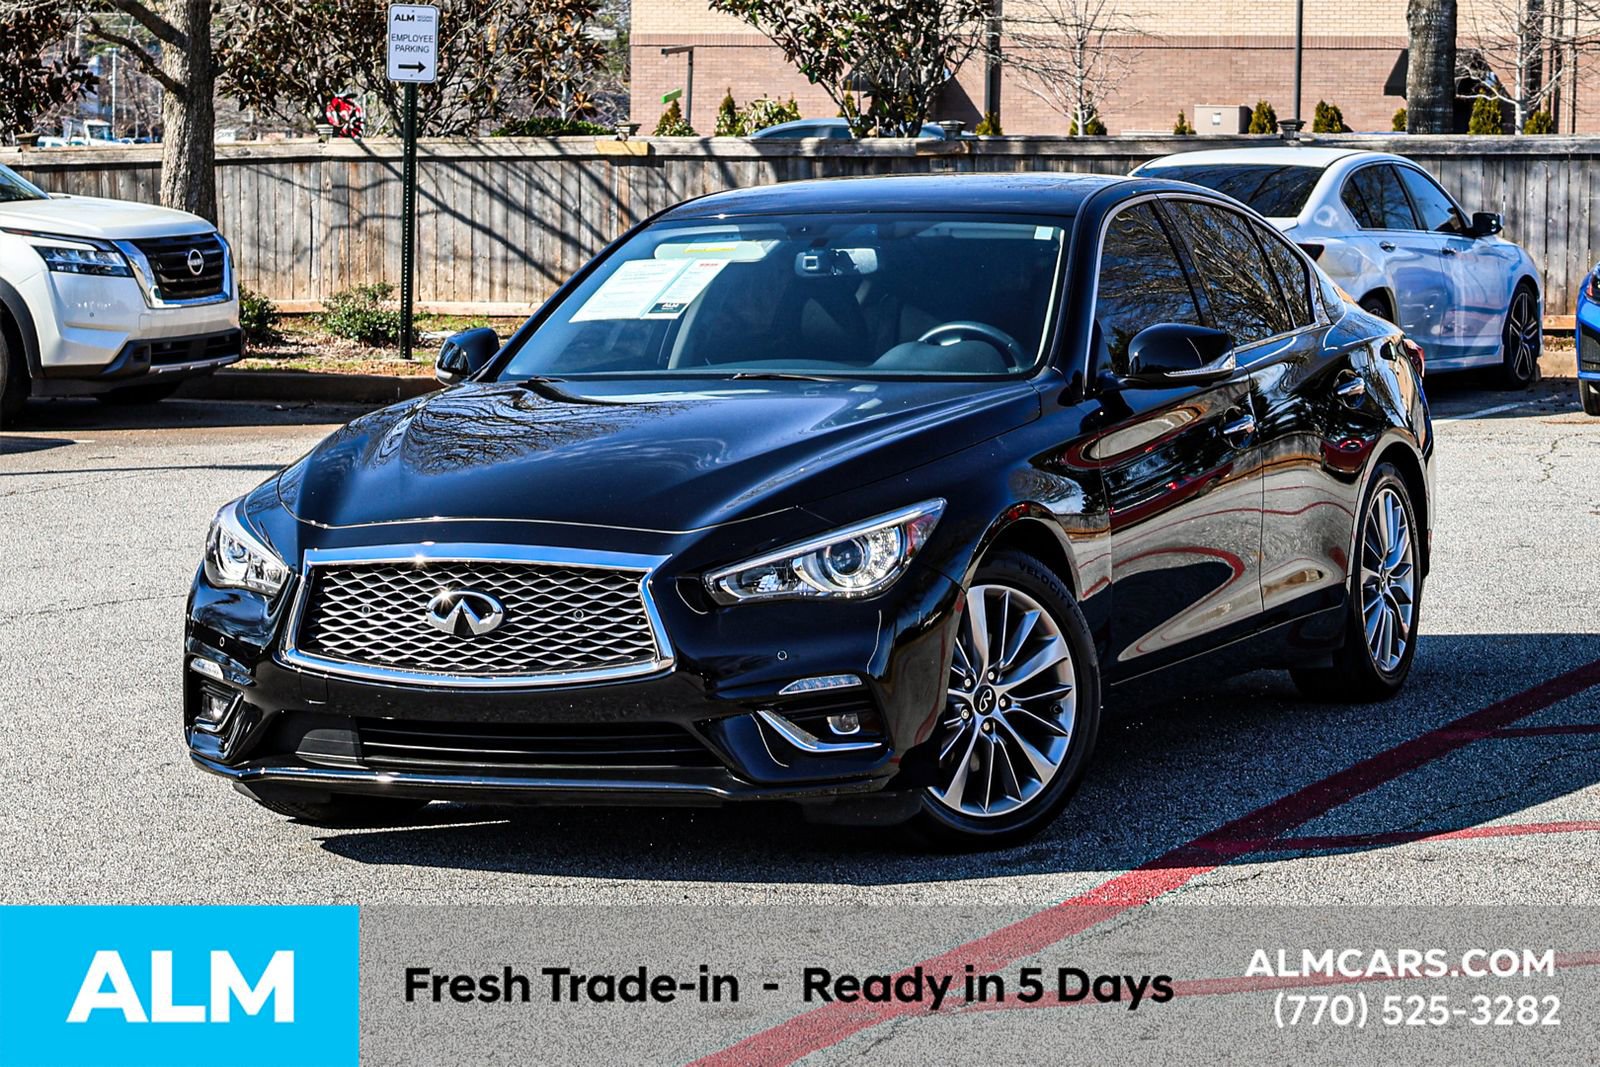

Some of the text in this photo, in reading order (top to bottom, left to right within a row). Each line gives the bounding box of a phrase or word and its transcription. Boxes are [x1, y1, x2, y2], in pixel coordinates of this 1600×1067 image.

[394, 14, 415, 22] ALM
[391, 33, 434, 43] EMPLOYEE
[395, 44, 430, 54] PARKING
